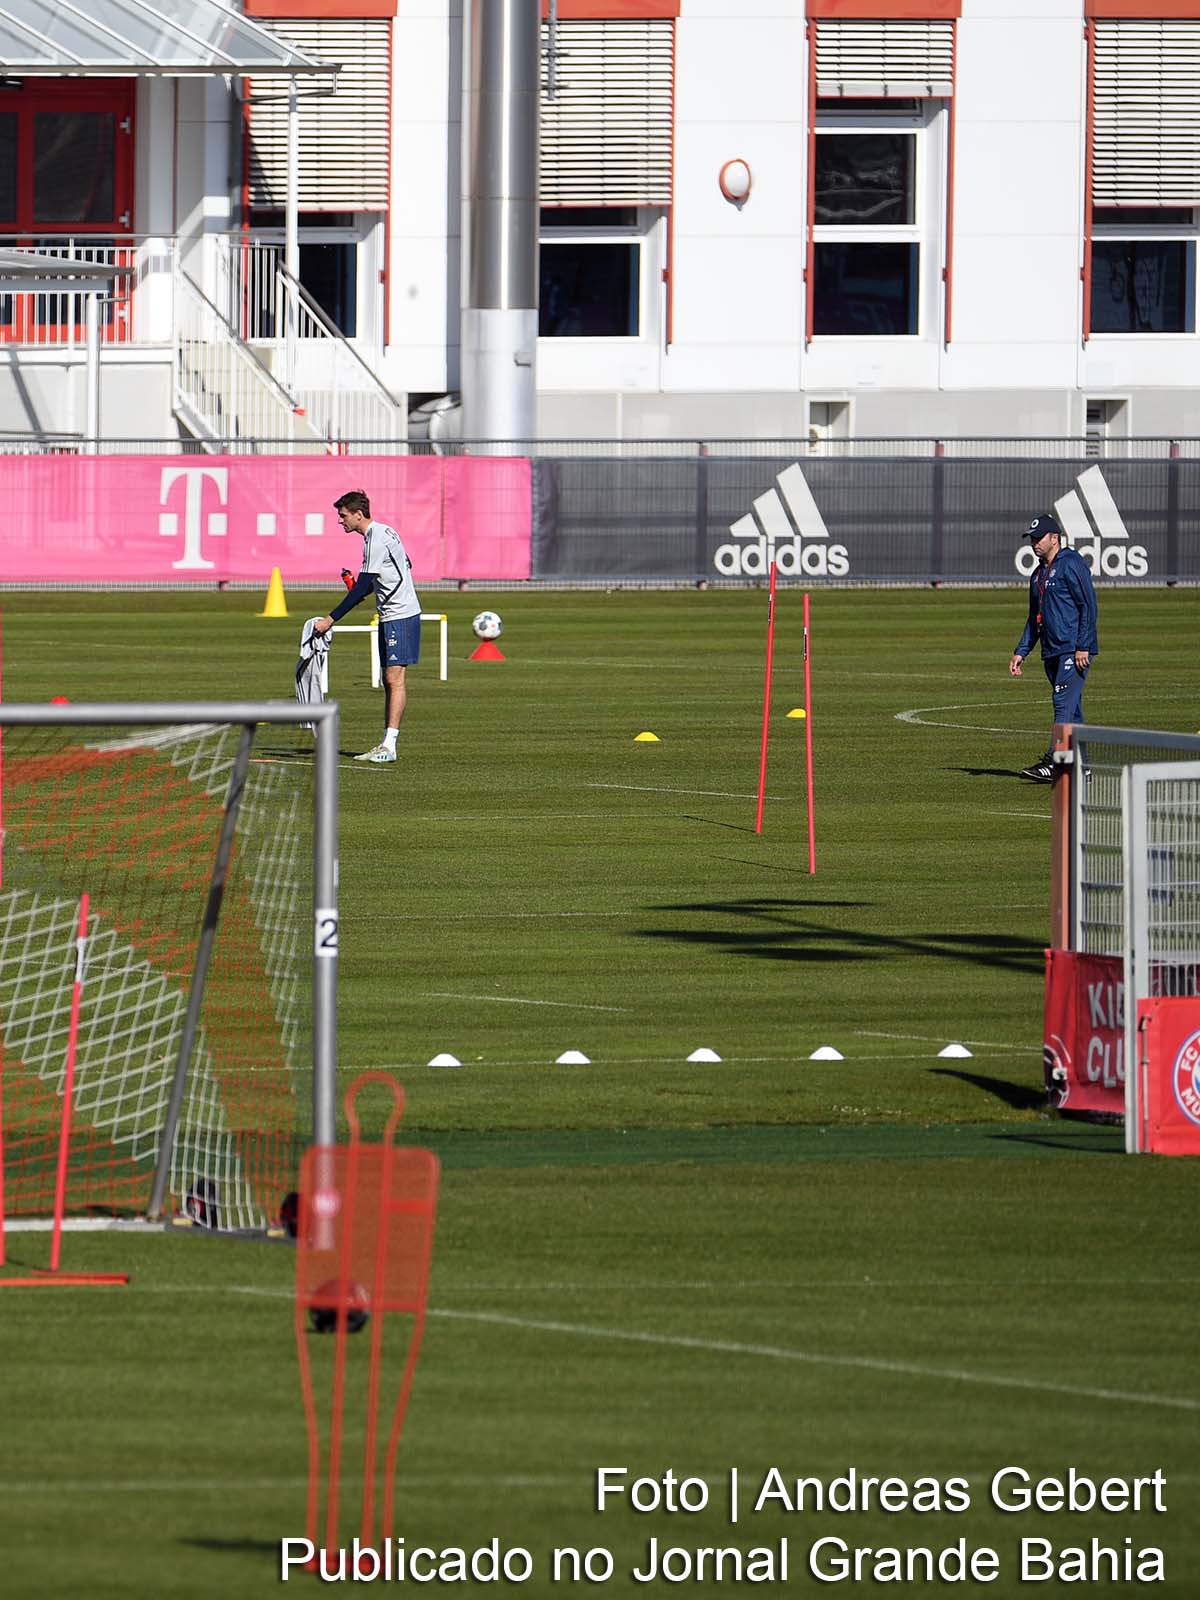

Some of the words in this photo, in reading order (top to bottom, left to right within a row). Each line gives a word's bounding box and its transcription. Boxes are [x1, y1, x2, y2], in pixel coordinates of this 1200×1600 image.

[713, 534, 850, 577] adidas
[1015, 536, 1149, 577] adas
[320, 918, 337, 948] 2
